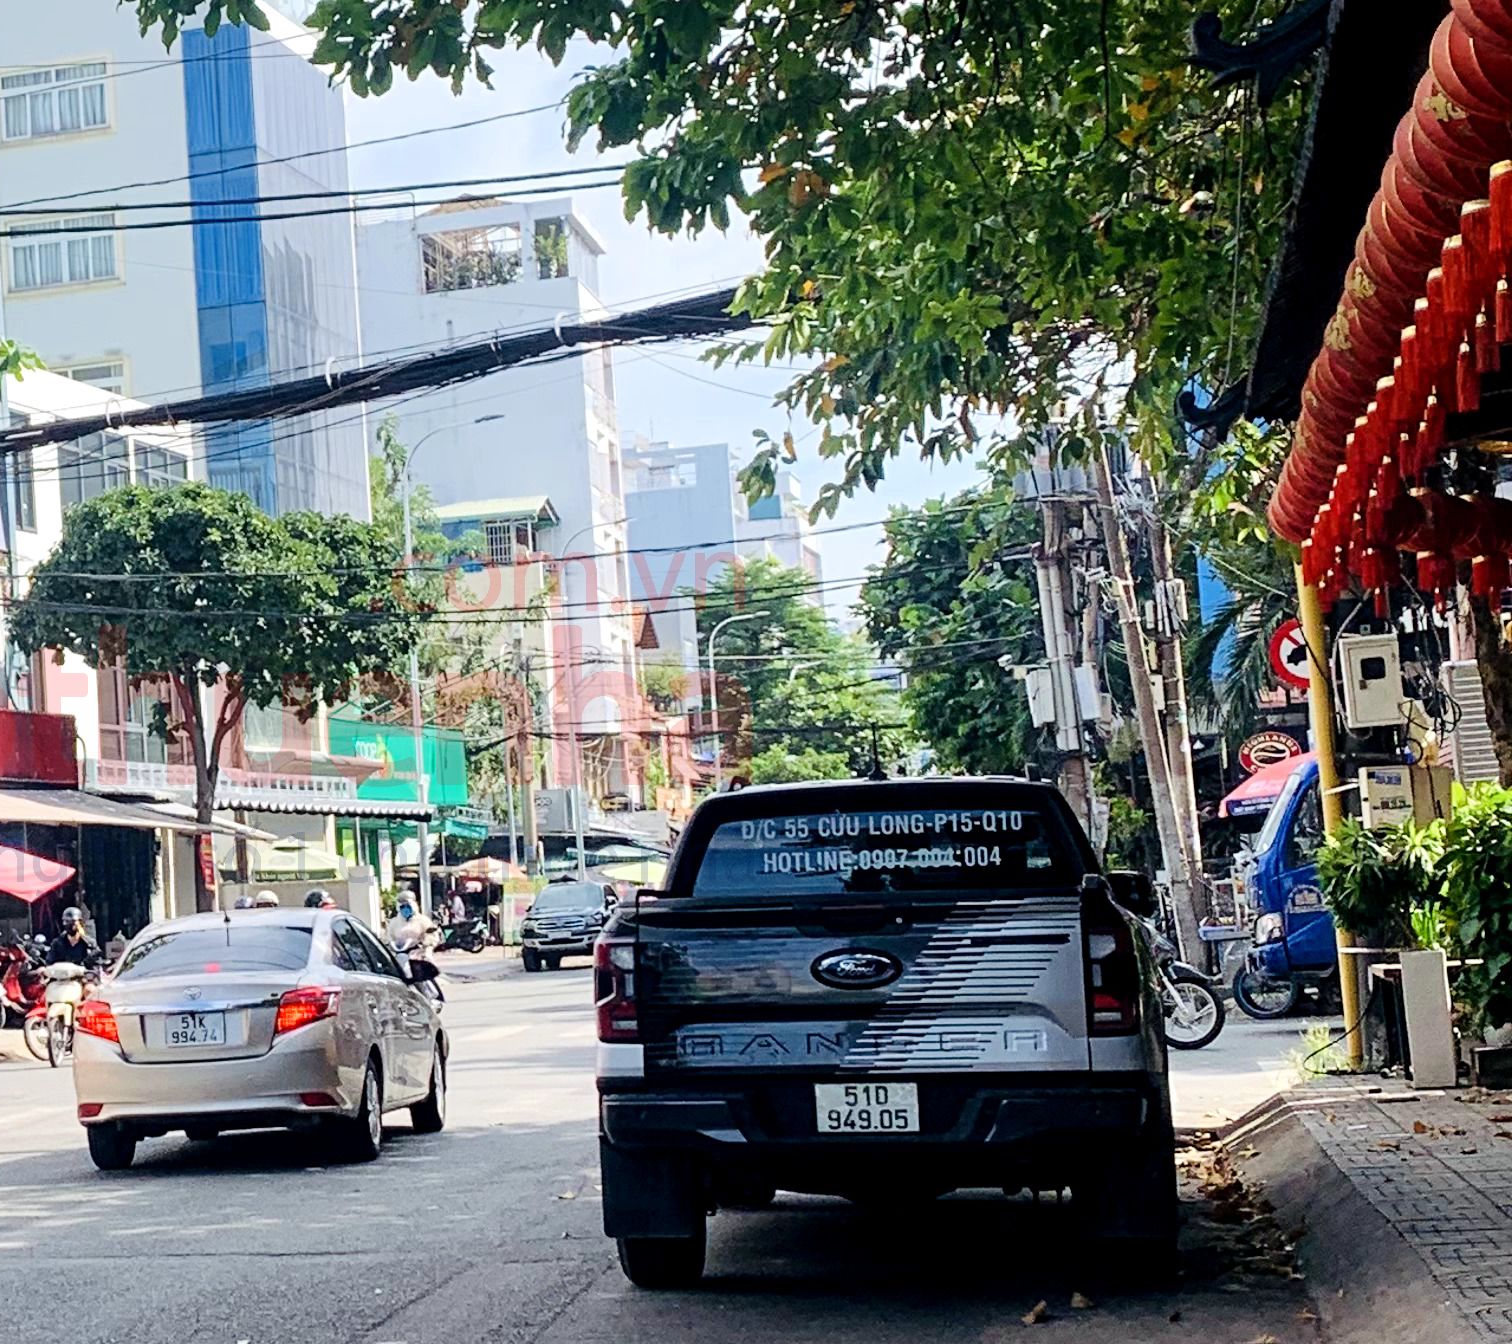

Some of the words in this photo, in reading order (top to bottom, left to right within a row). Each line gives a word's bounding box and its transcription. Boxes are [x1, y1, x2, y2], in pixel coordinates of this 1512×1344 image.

[741, 818, 776, 843] Đ/C
[785, 818, 809, 838] 55
[869, 810, 1023, 836] LONG-P15-Q10
[844, 1086, 889, 1108] 51D
[827, 1109, 910, 1131] 949.05
